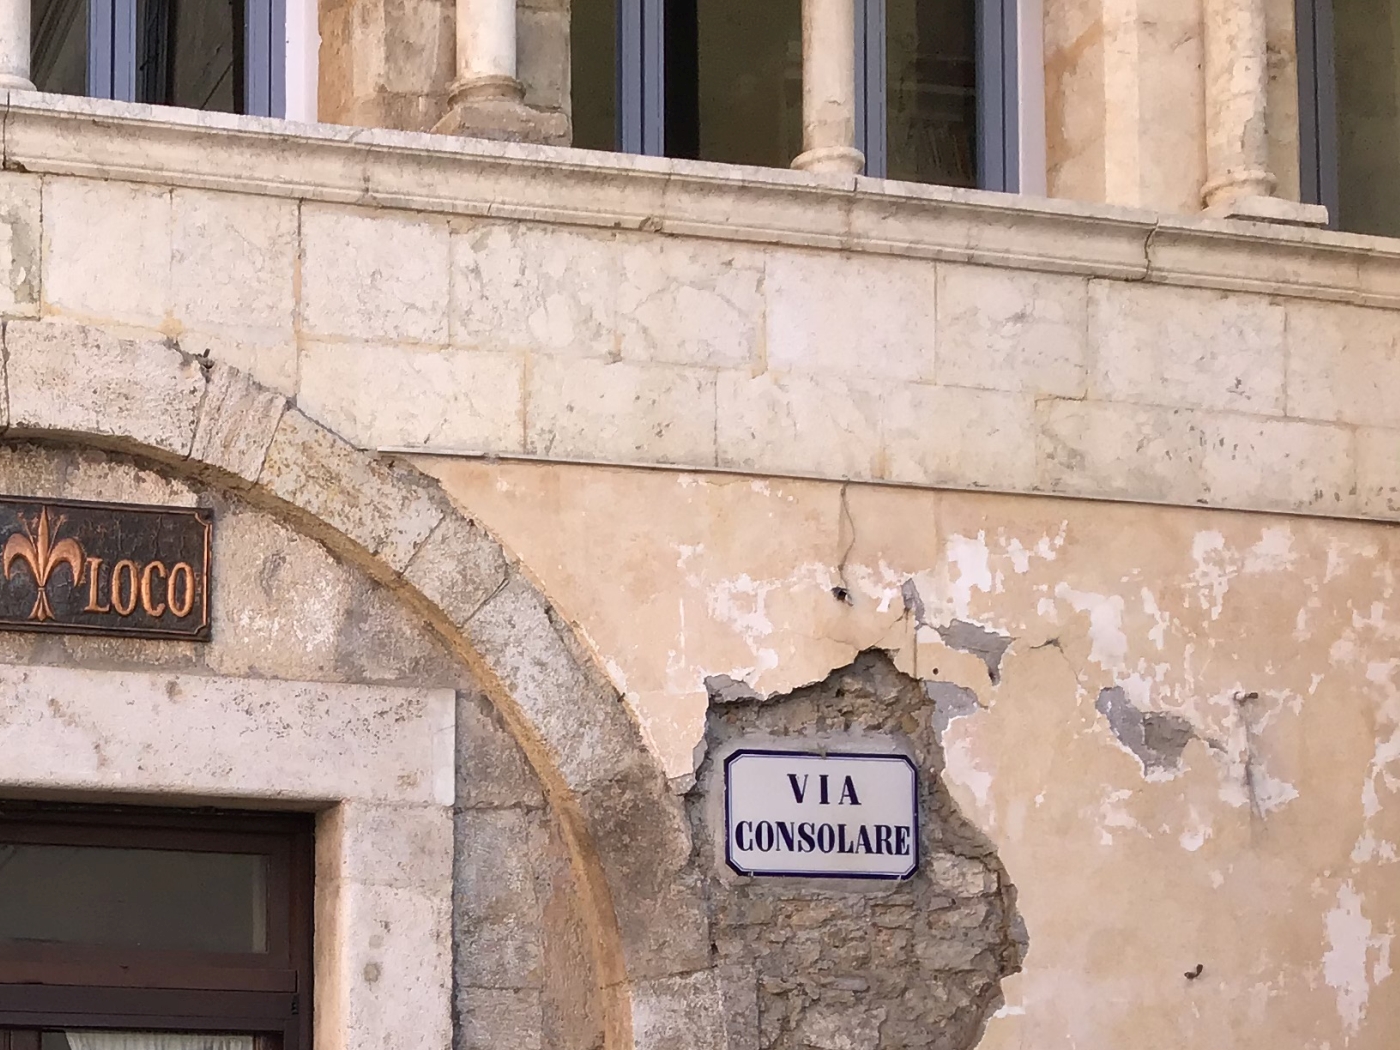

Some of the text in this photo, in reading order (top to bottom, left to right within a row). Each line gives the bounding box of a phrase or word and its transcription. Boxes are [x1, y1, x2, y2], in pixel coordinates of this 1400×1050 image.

[84, 557, 196, 617] LOCO
[787, 773, 862, 806] VIA
[735, 820, 910, 856] CONSOLARE
